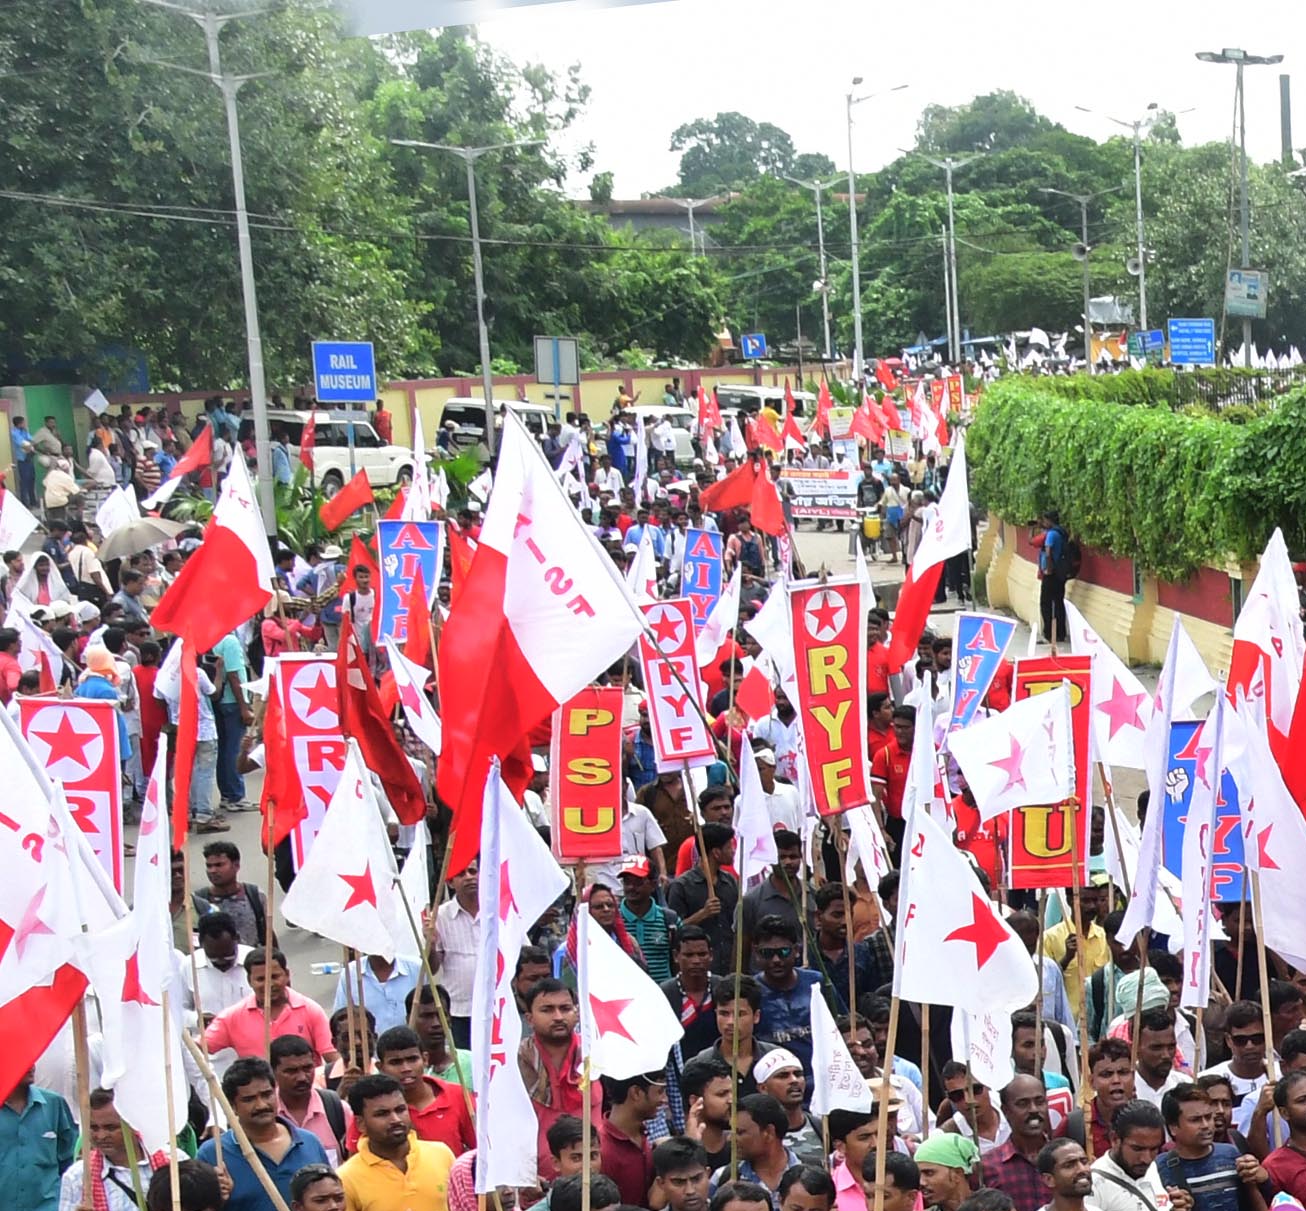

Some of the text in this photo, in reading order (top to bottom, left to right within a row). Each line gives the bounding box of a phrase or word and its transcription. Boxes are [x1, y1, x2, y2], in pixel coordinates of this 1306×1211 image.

[320, 374, 371, 389] MUSEUM
[329, 354, 357, 369] RAIL
[658, 660, 693, 751] RYF
[806, 644, 853, 811] RYF
[563, 708, 615, 835] PSU
